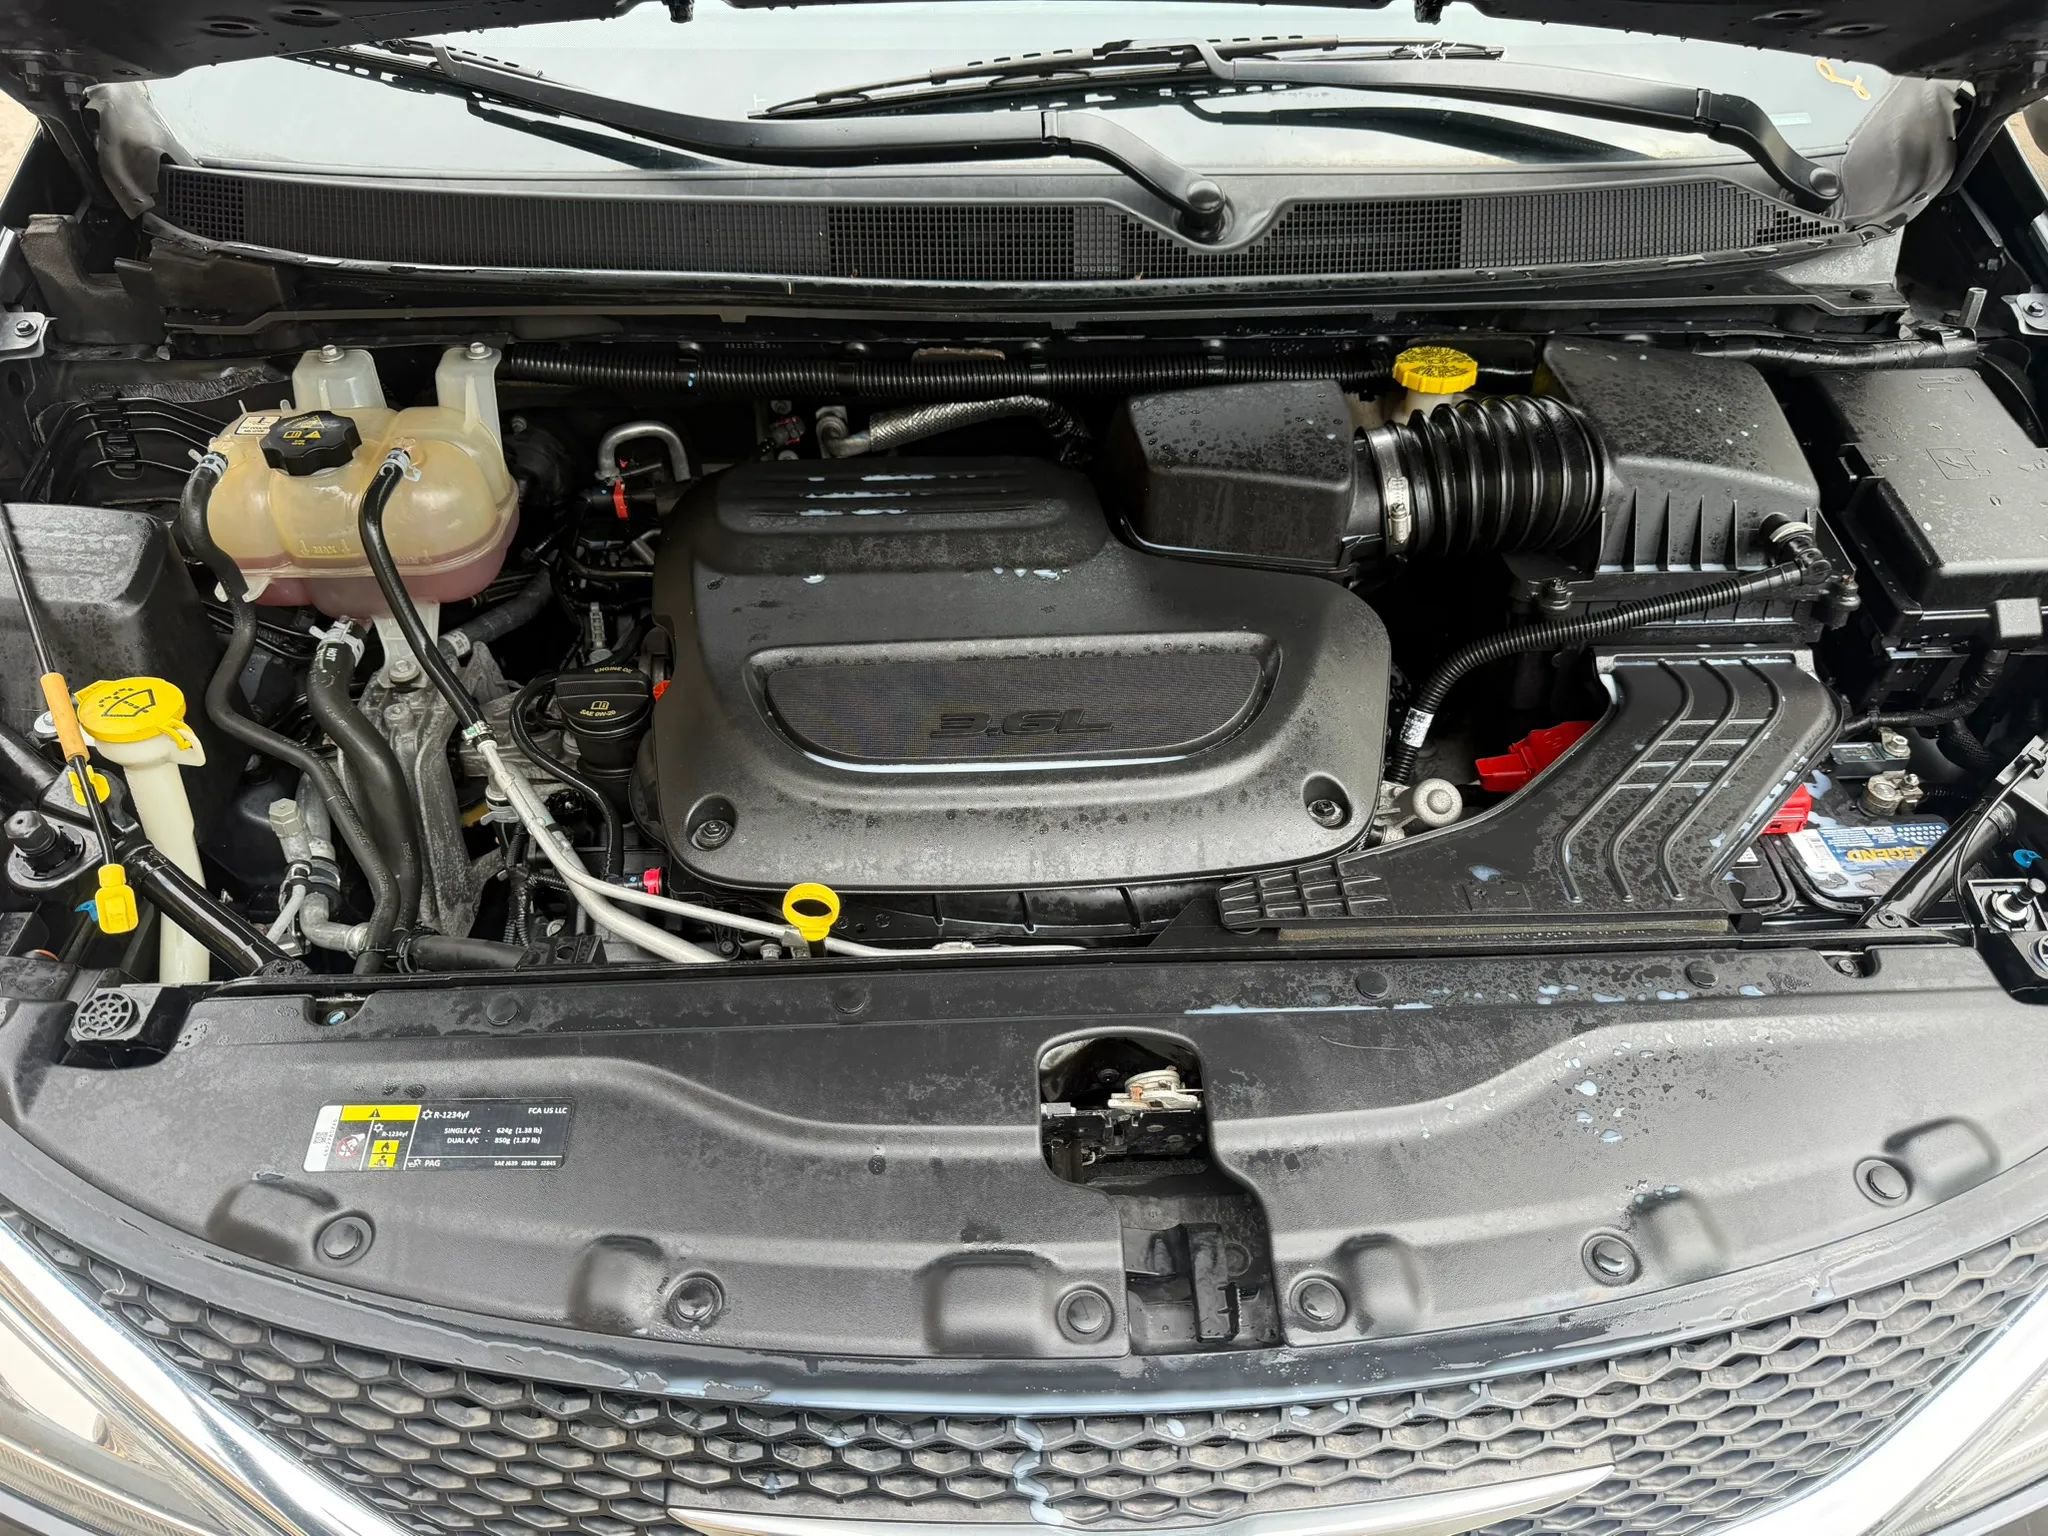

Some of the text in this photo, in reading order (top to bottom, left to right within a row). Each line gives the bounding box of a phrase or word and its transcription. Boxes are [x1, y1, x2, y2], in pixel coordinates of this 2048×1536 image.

[930, 708, 1114, 739] 3.6L
[433, 1110, 470, 1120] R-1234yf
[533, 1127, 543, 1135] lb)
